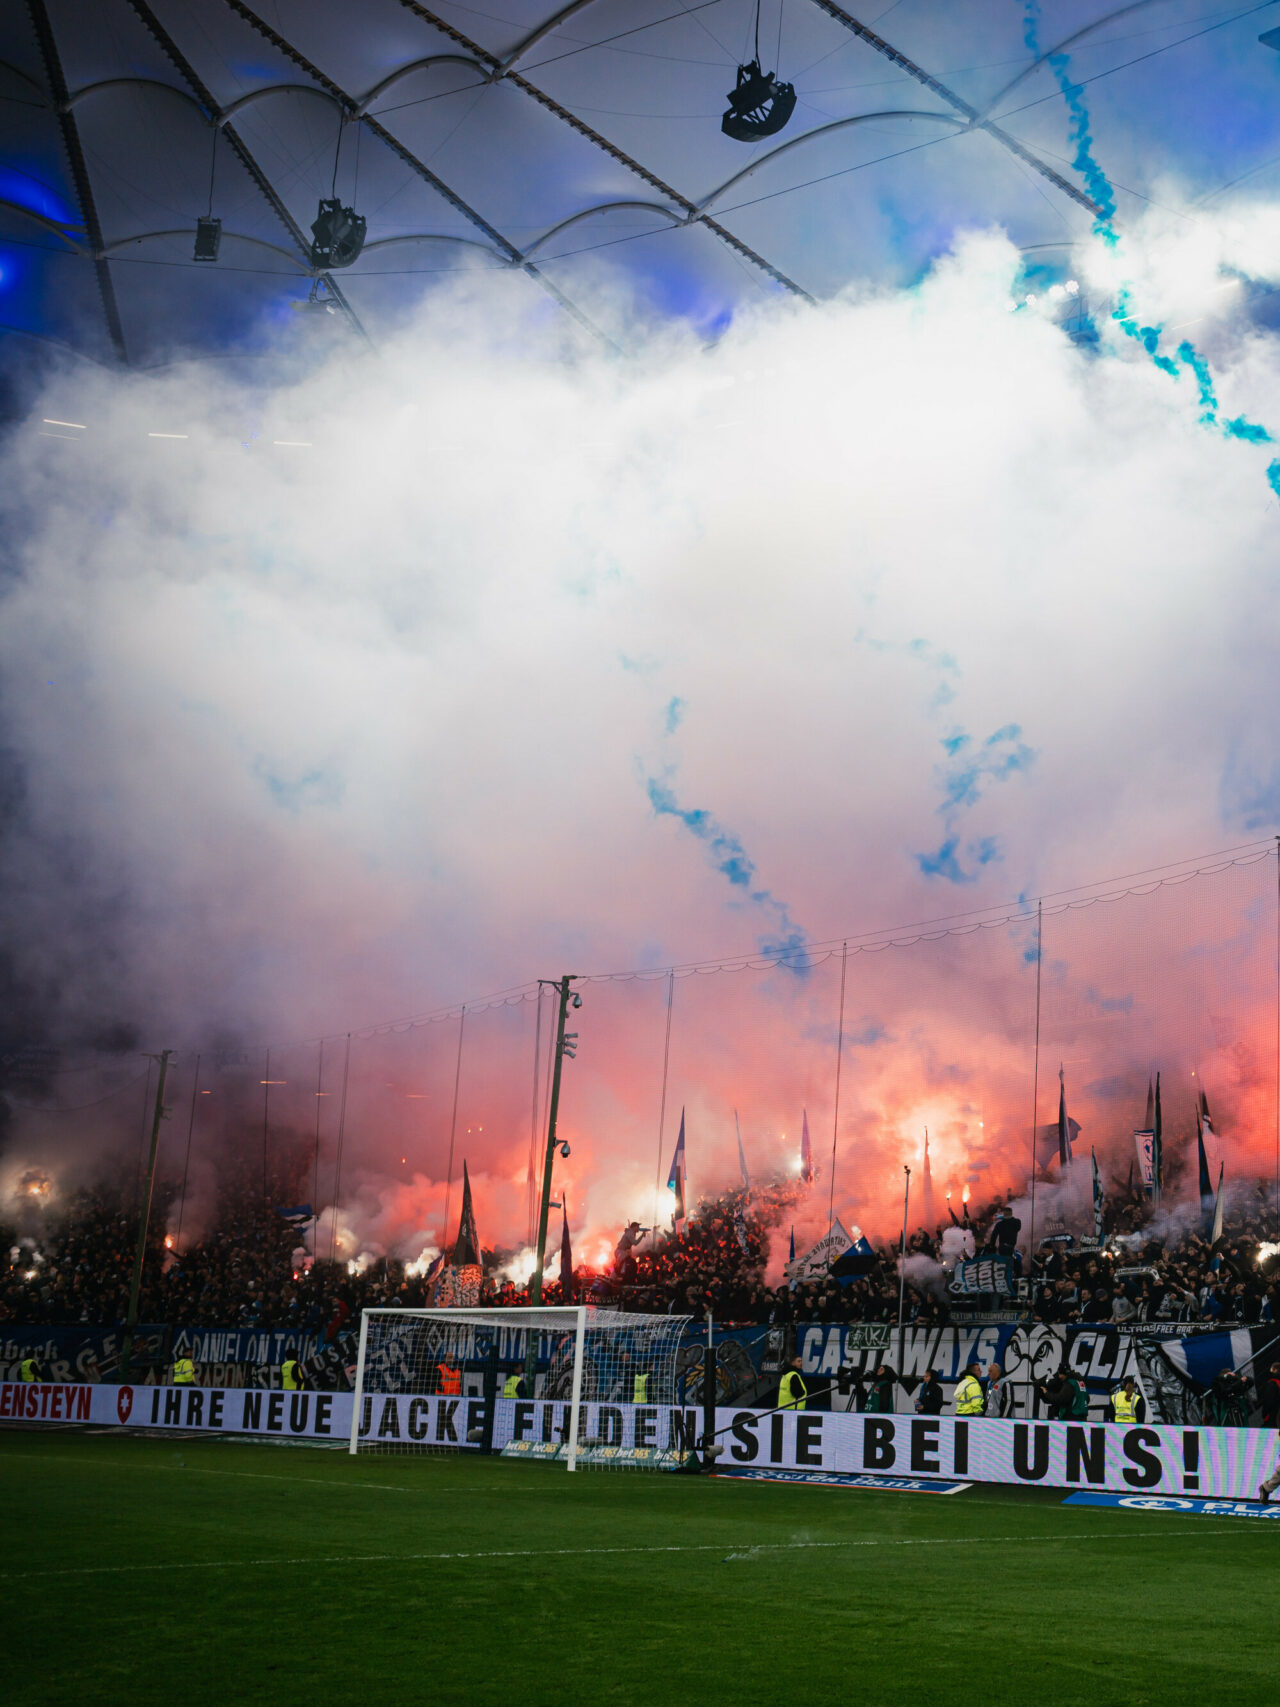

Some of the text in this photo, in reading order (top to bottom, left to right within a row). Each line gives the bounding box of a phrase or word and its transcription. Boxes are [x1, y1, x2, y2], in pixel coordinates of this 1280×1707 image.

[151, 1389, 225, 1428] IHRE
[242, 1392, 333, 1435] NEUE
[731, 1411, 823, 1466] SIE
[863, 1417, 969, 1475] BEI
[1013, 1424, 1200, 1491] UNS!
[617, 1447, 651, 1460] bet365
